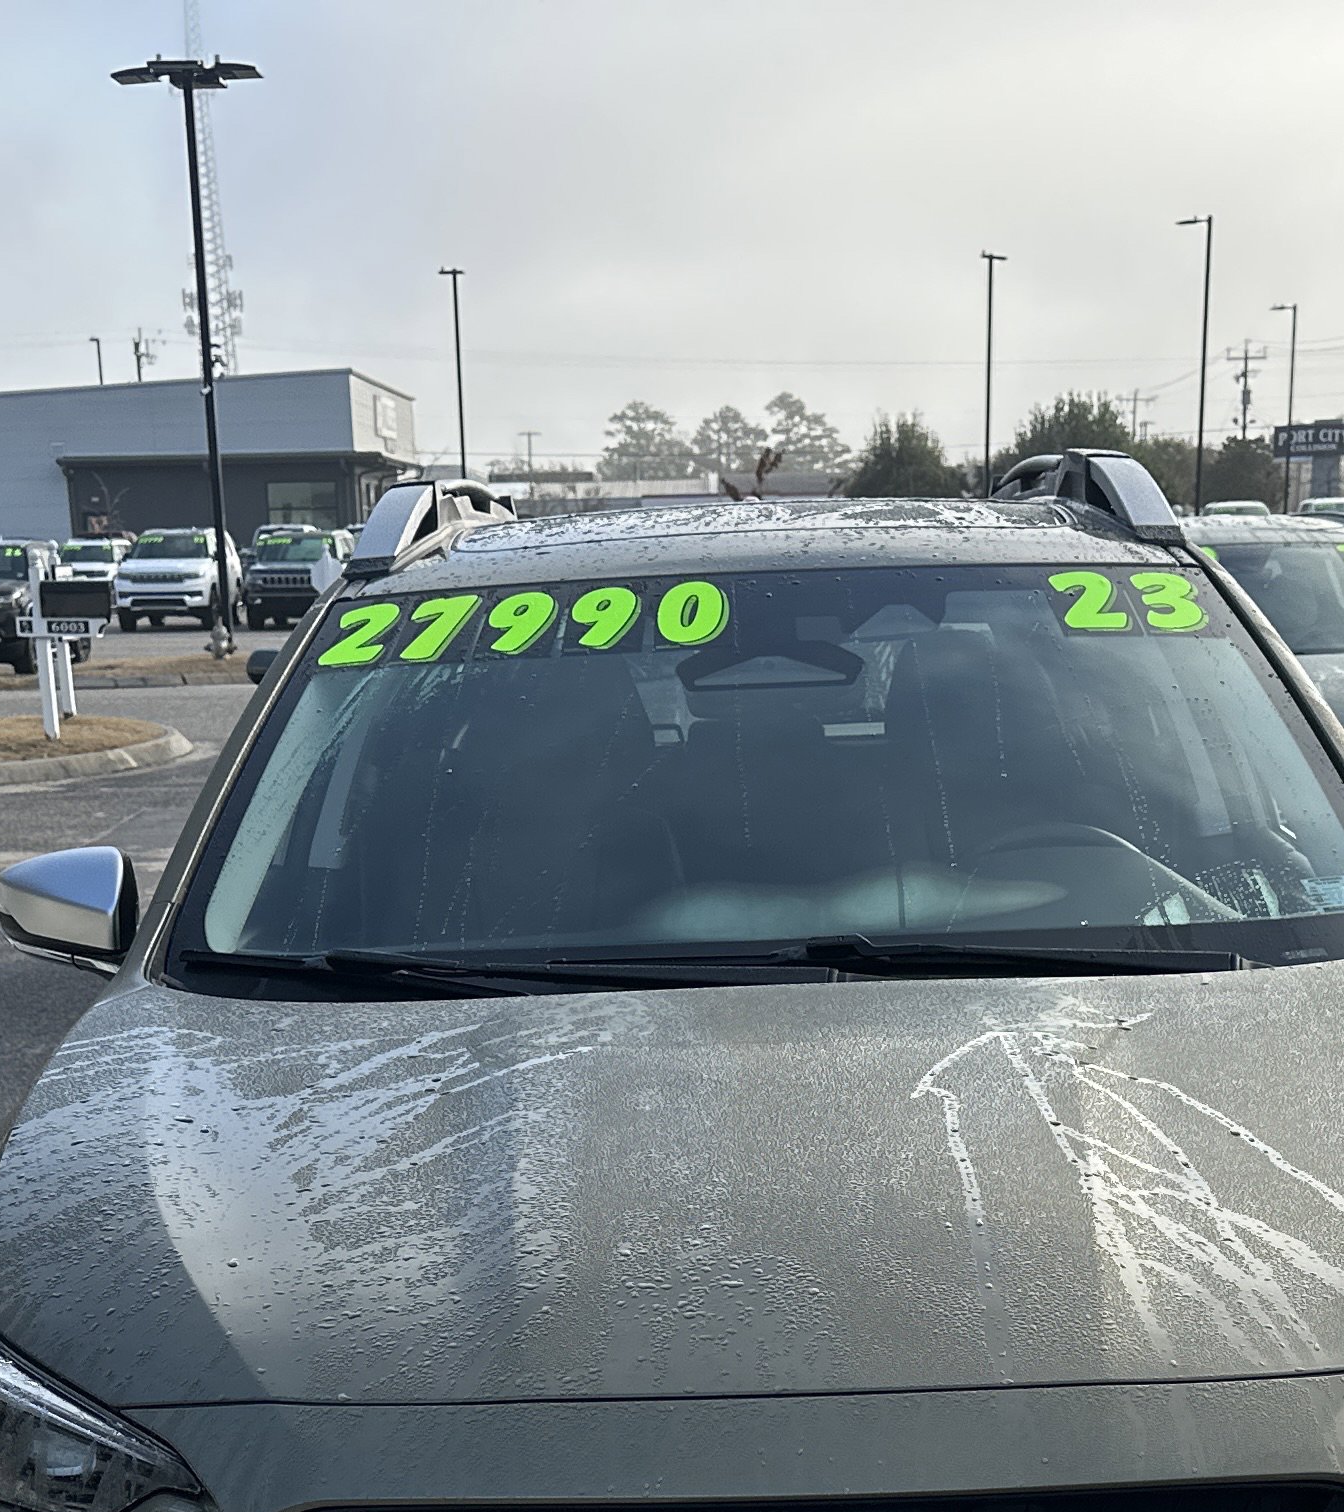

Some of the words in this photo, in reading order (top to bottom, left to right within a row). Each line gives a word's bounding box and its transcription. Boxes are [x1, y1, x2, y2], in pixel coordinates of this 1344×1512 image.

[51, 622, 85, 633] 6003
[317, 579, 731, 668] 27990
[1048, 570, 1209, 633] 23
